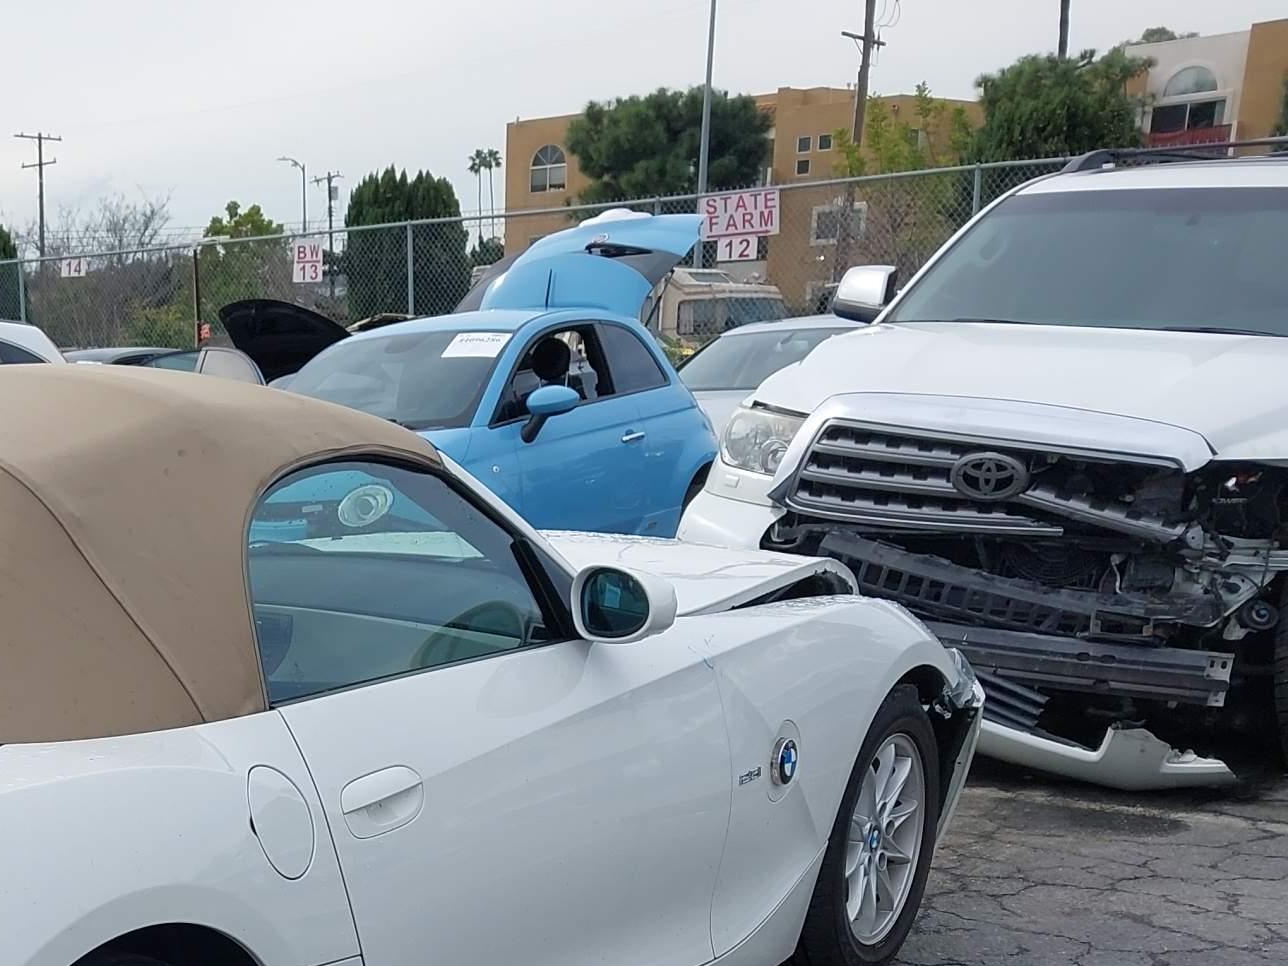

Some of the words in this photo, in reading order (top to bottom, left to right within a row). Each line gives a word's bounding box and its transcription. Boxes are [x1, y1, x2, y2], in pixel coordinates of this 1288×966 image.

[706, 191, 776, 215] STATE
[708, 209, 774, 233] FARM
[297, 244, 320, 260] BW
[724, 238, 751, 259] 12
[65, 260, 82, 276] 14
[299, 264, 318, 281] 13
